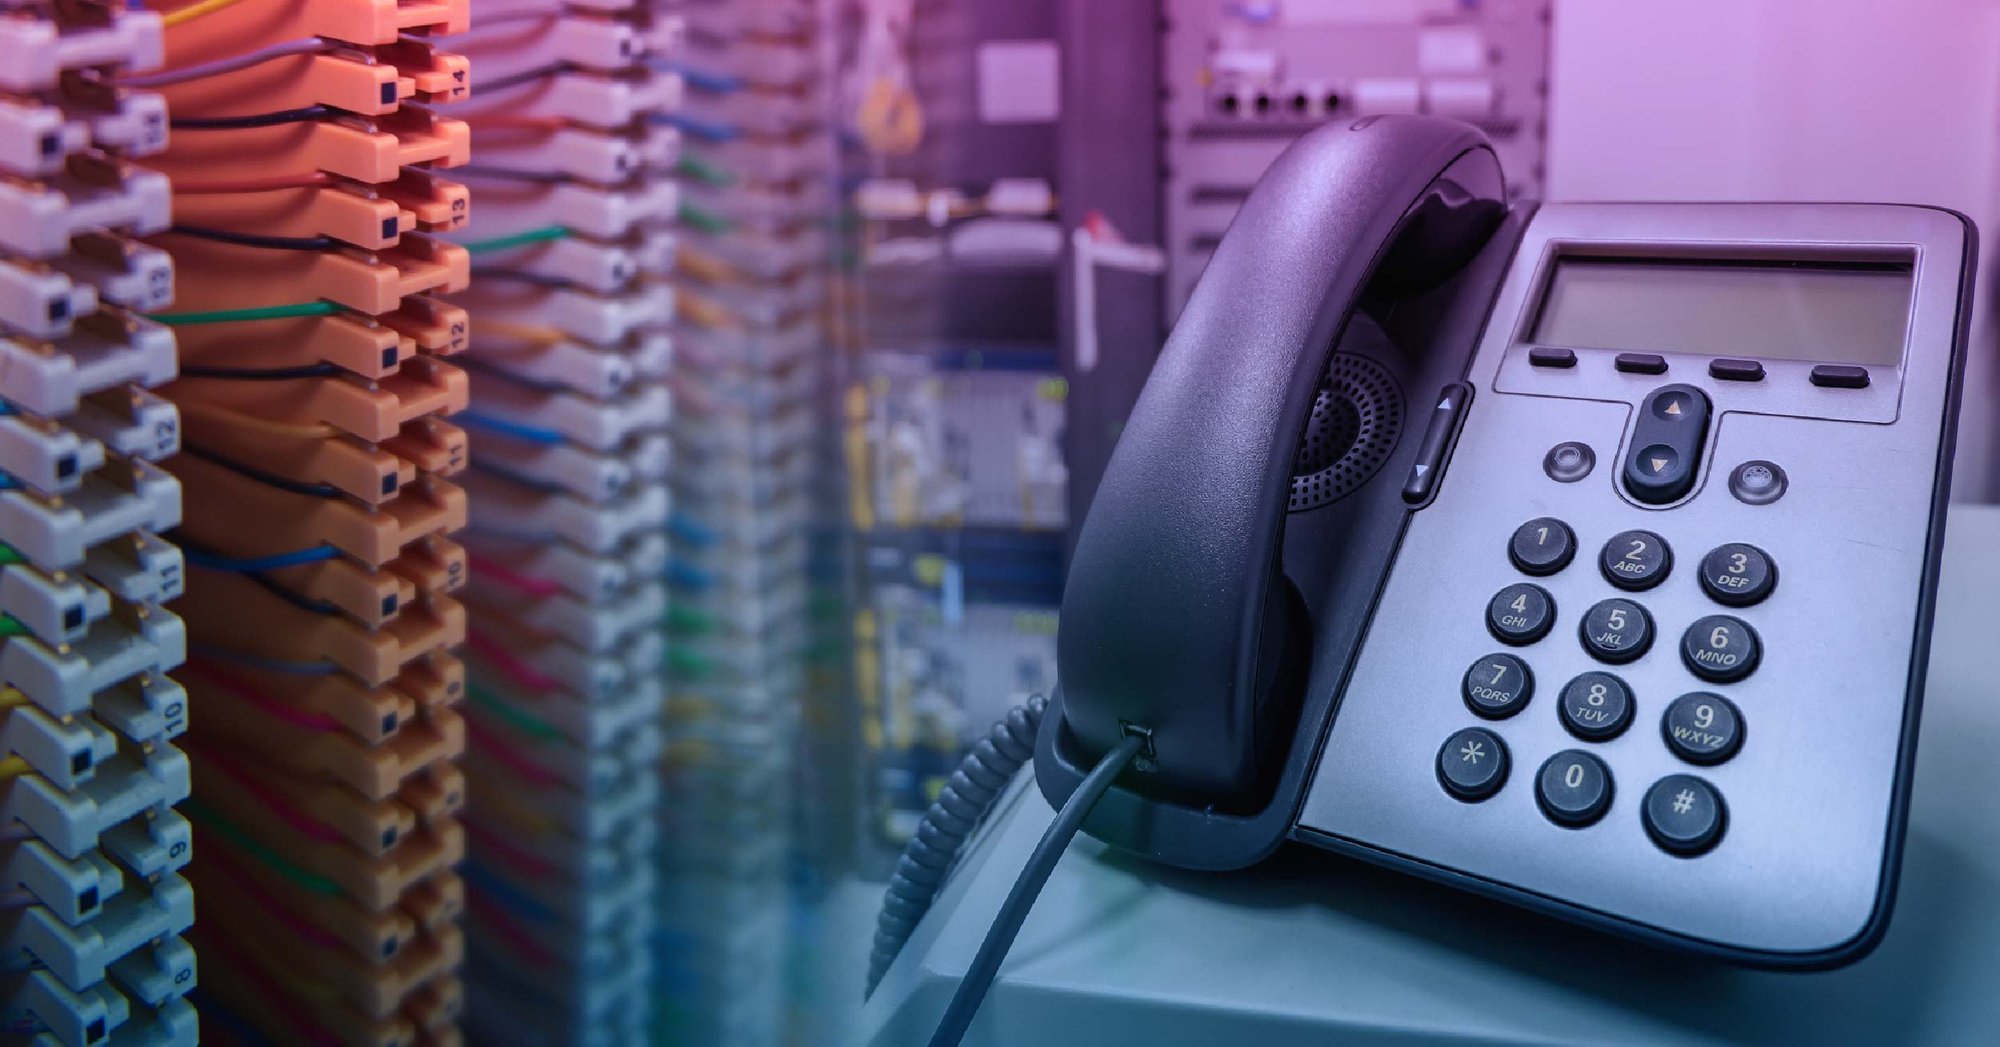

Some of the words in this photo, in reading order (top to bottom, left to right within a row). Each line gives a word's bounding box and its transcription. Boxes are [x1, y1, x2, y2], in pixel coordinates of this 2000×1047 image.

[452, 69, 466, 95] 14
[451, 198, 466, 224] 13
[451, 321, 465, 347] 12
[157, 421, 175, 450] 12
[449, 443, 463, 467] 11
[1537, 527, 1548, 545] 1
[1625, 540, 1646, 561] 2
[1613, 560, 1646, 574] ABC
[1728, 553, 1748, 574] 3
[161, 564, 179, 591] 11
[1717, 575, 1750, 588] DEF
[1510, 593, 1527, 613] 4
[1501, 615, 1527, 627] GHI
[1607, 609, 1627, 630] 5
[1596, 632, 1622, 645] JKL
[1710, 626, 1730, 649] 6
[1696, 649, 1737, 665] MNO
[1490, 663, 1507, 685] 7
[1471, 686, 1511, 702] PQRS
[1587, 683, 1607, 706] 8
[164, 702, 183, 733] 10
[1576, 707, 1609, 722] TUV
[1694, 704, 1714, 728] 9
[1673, 726, 1725, 748] WXYZ
[1564, 763, 1585, 788] 0
[1673, 788, 1696, 814] #
[169, 841, 187, 859] 9
[174, 968, 192, 985] 8
